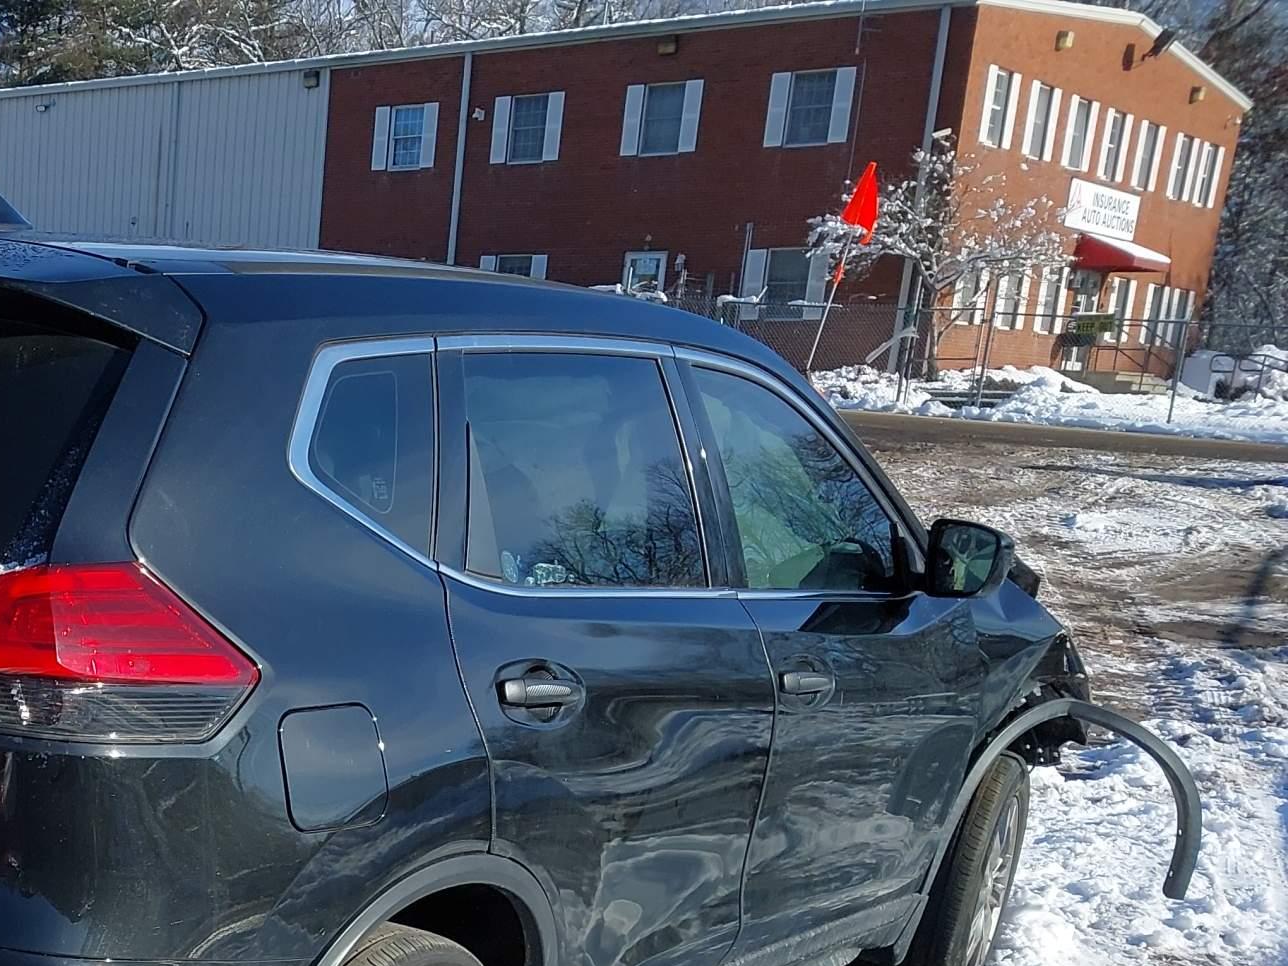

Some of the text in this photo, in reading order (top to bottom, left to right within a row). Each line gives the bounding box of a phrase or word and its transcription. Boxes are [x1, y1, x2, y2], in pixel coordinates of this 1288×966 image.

[1092, 192, 1131, 216] INSURANCE
[1081, 207, 1135, 234] AUTO AUCTIONS
